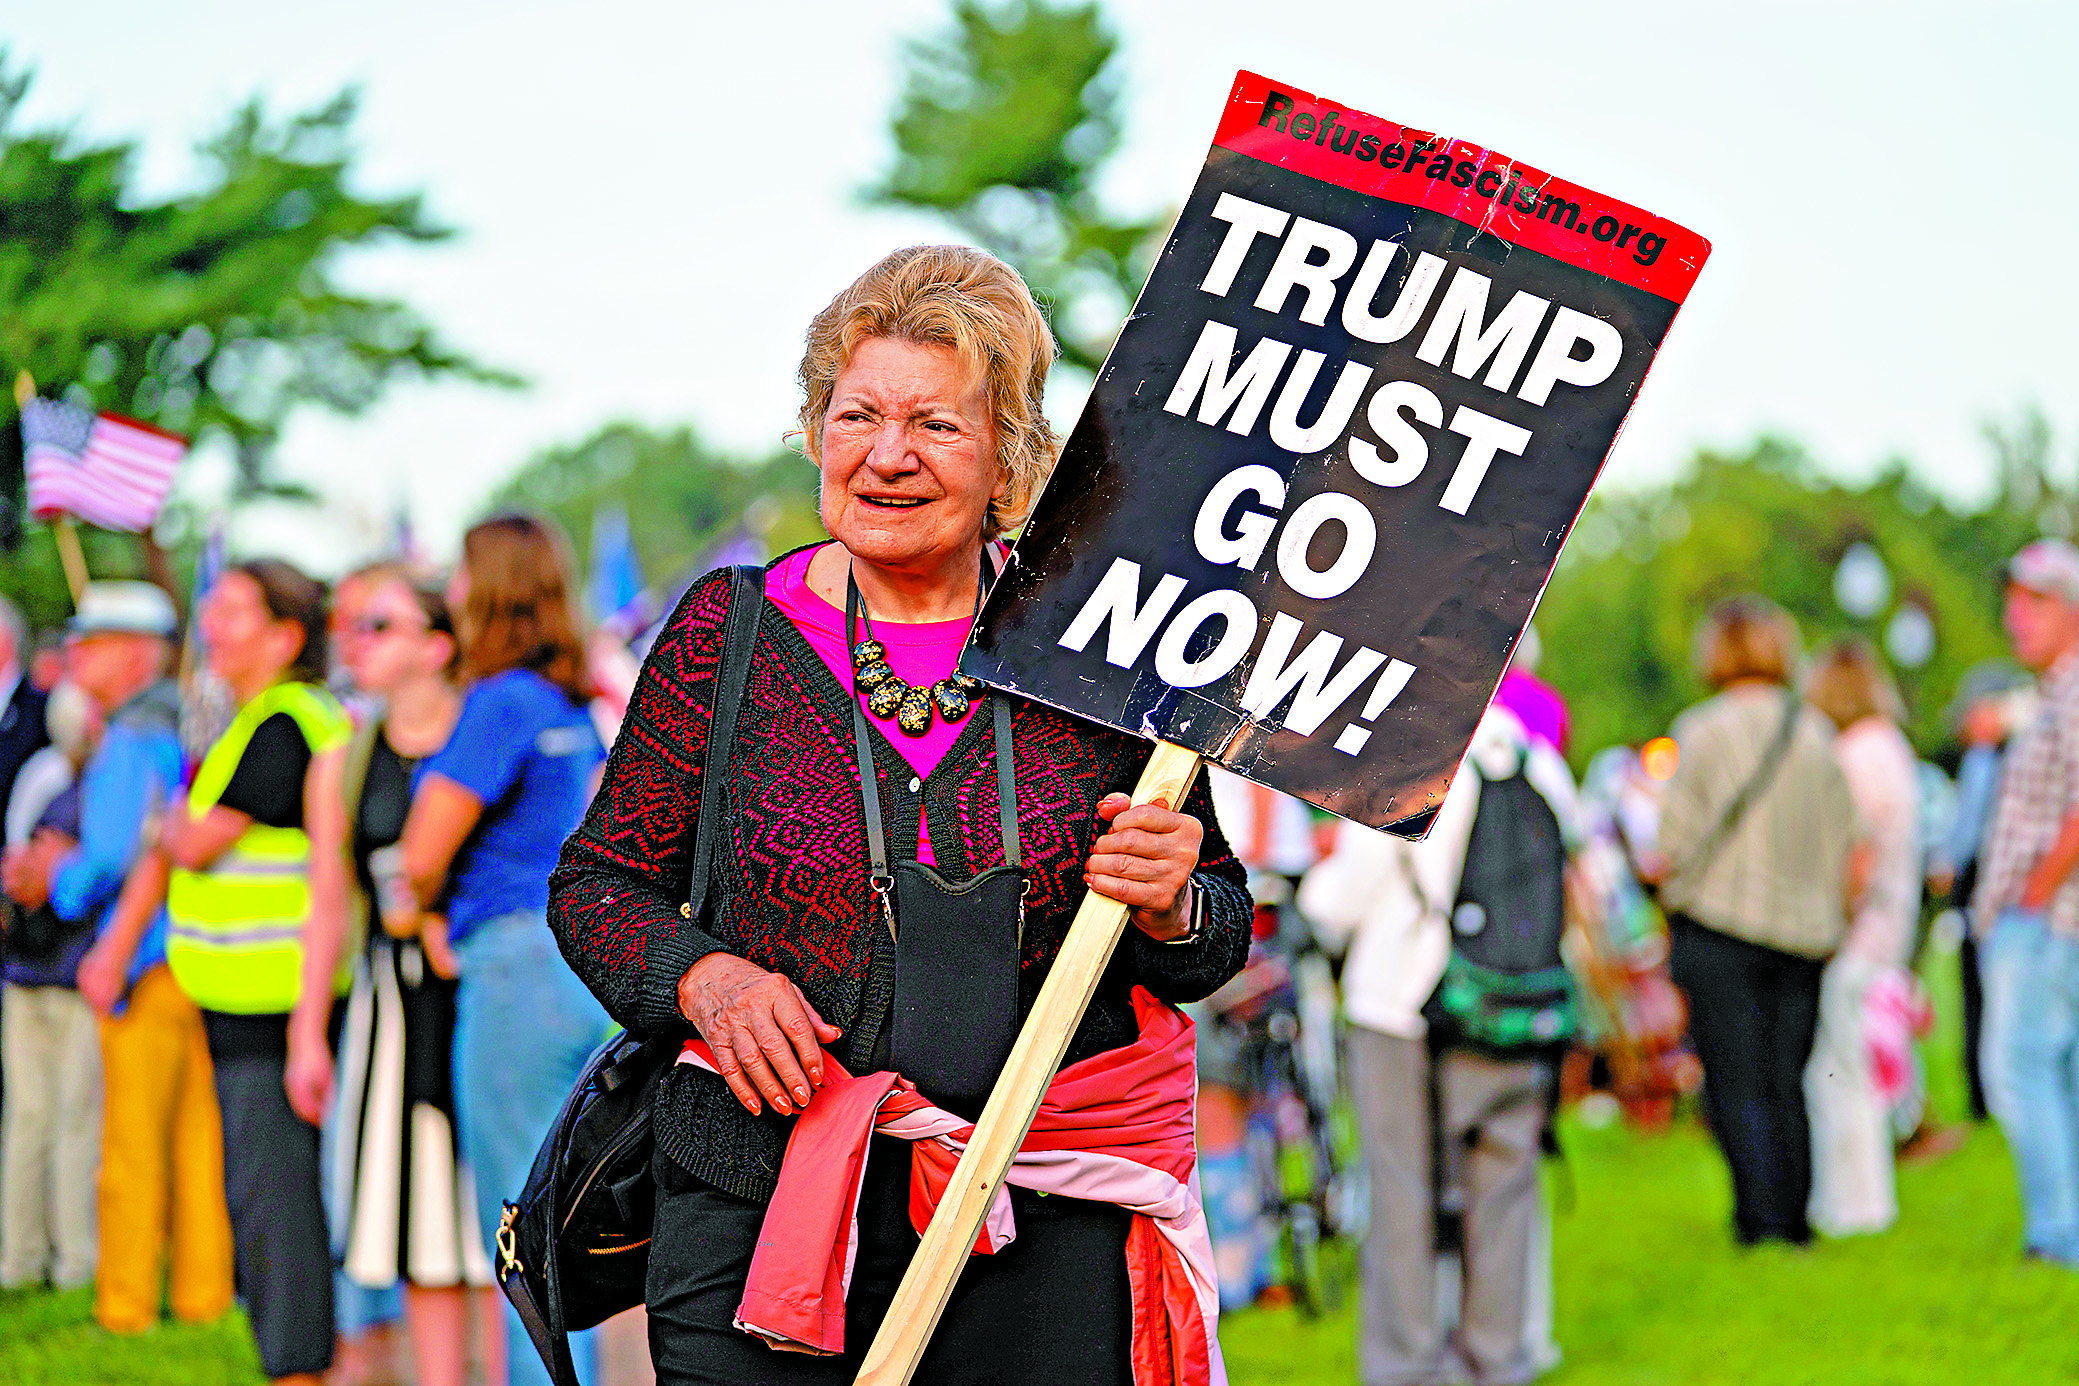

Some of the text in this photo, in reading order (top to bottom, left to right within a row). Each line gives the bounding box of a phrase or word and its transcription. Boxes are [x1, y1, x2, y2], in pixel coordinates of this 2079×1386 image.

[1258, 90, 1667, 266] RefuseFascism.org
[1199, 191, 1623, 407] TRUMP
[1162, 319, 1534, 516] MUST
[1193, 464, 1377, 599] GO
[1056, 556, 1418, 757] NOW!
